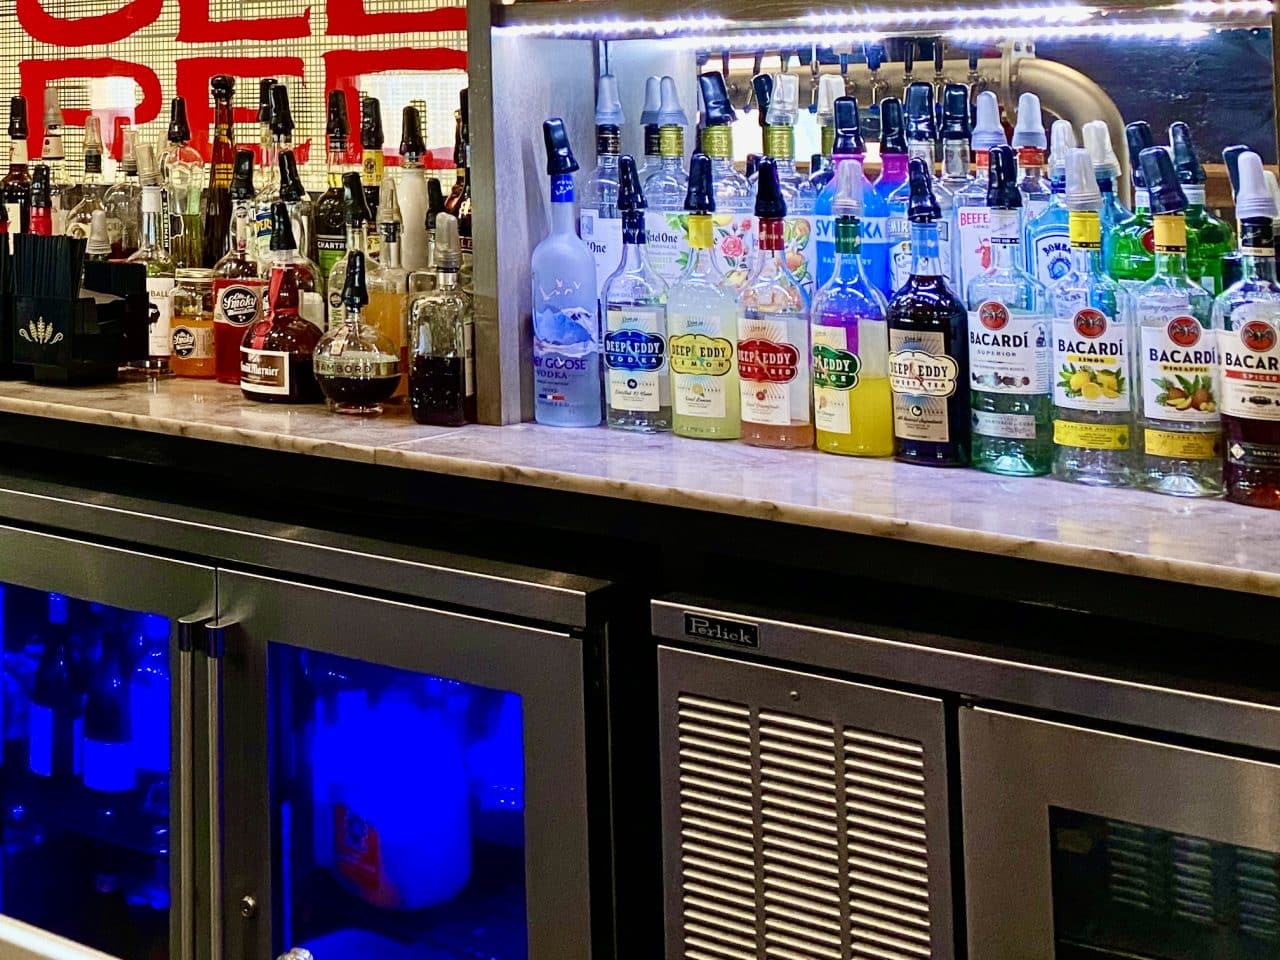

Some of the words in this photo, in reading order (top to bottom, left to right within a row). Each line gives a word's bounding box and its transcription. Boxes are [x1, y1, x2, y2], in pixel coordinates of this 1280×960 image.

[960, 212, 989, 226] BEEFE
[816, 219, 882, 238] SVKA
[661, 232, 677, 243] One
[318, 241, 346, 249] CHARTR
[1042, 242, 1070, 256] BOMBA
[223, 294, 257, 309] Smoky
[970, 331, 1028, 348] BACARDÍ
[606, 340, 626, 353] DEEP
[634, 342, 660, 354] EDDY
[672, 344, 691, 356] DEEP
[700, 347, 726, 358] EDDY
[977, 349, 1017, 357] SUPERIOR
[1058, 338, 1123, 356] BACARDÍ
[763, 352, 792, 365] EDDY
[1149, 347, 1216, 364] BACARDÍ
[1226, 352, 1279, 371] BACAR
[320, 363, 372, 373] AMBORD
[545, 357, 587, 371] GOOSE
[674, 359, 724, 368] LEMON
[824, 358, 850, 371] EDDY
[919, 364, 948, 378] EDDY
[689, 617, 752, 644] Perlick
